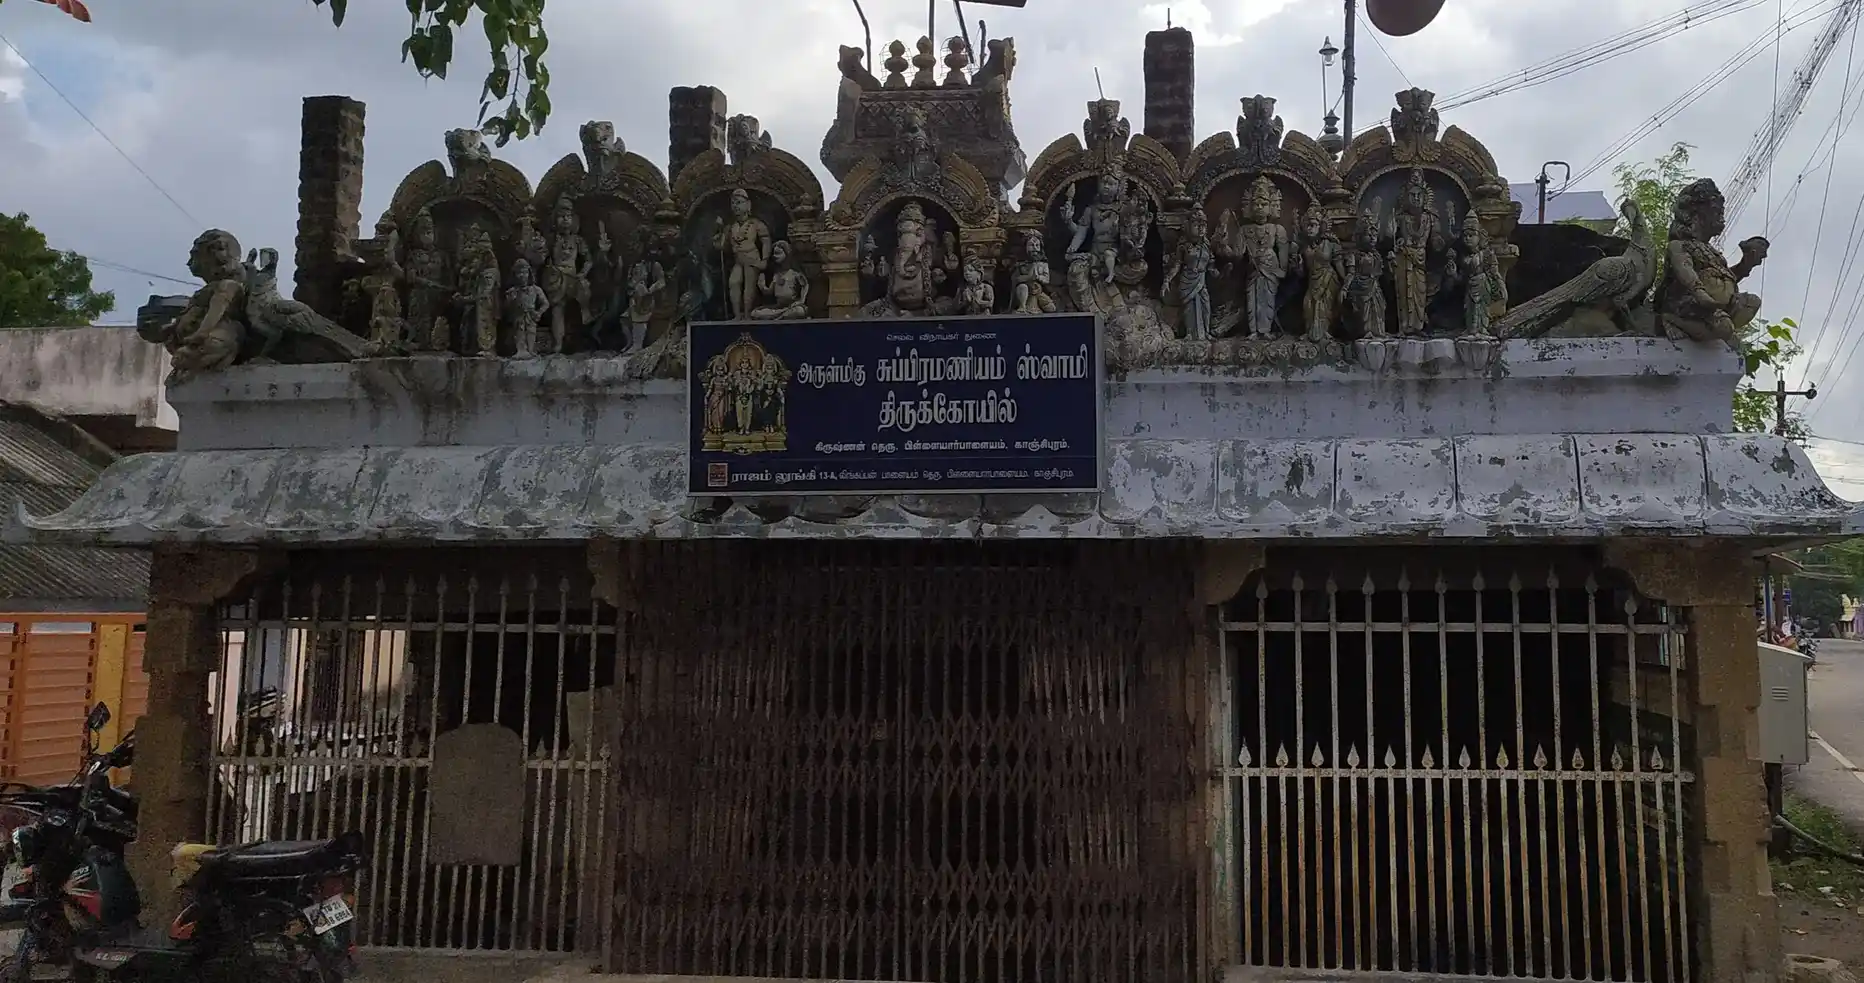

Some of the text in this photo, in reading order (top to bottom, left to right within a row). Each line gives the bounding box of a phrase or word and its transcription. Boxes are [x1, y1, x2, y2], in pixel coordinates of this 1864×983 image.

[919, 331, 960, 342] விநாயகர்
[964, 333, 997, 341] துணை
[797, 343, 1088, 389] அருள்மிகு சுப்பிரமணியம் ஸ்வாமி
[877, 386, 1018, 432] திருக்கோயில்
[815, 441, 866, 454] கிருஷ்ணன்
[731, 469, 773, 483] ராஜம்
[881, 469, 919, 480] பாளையம்
